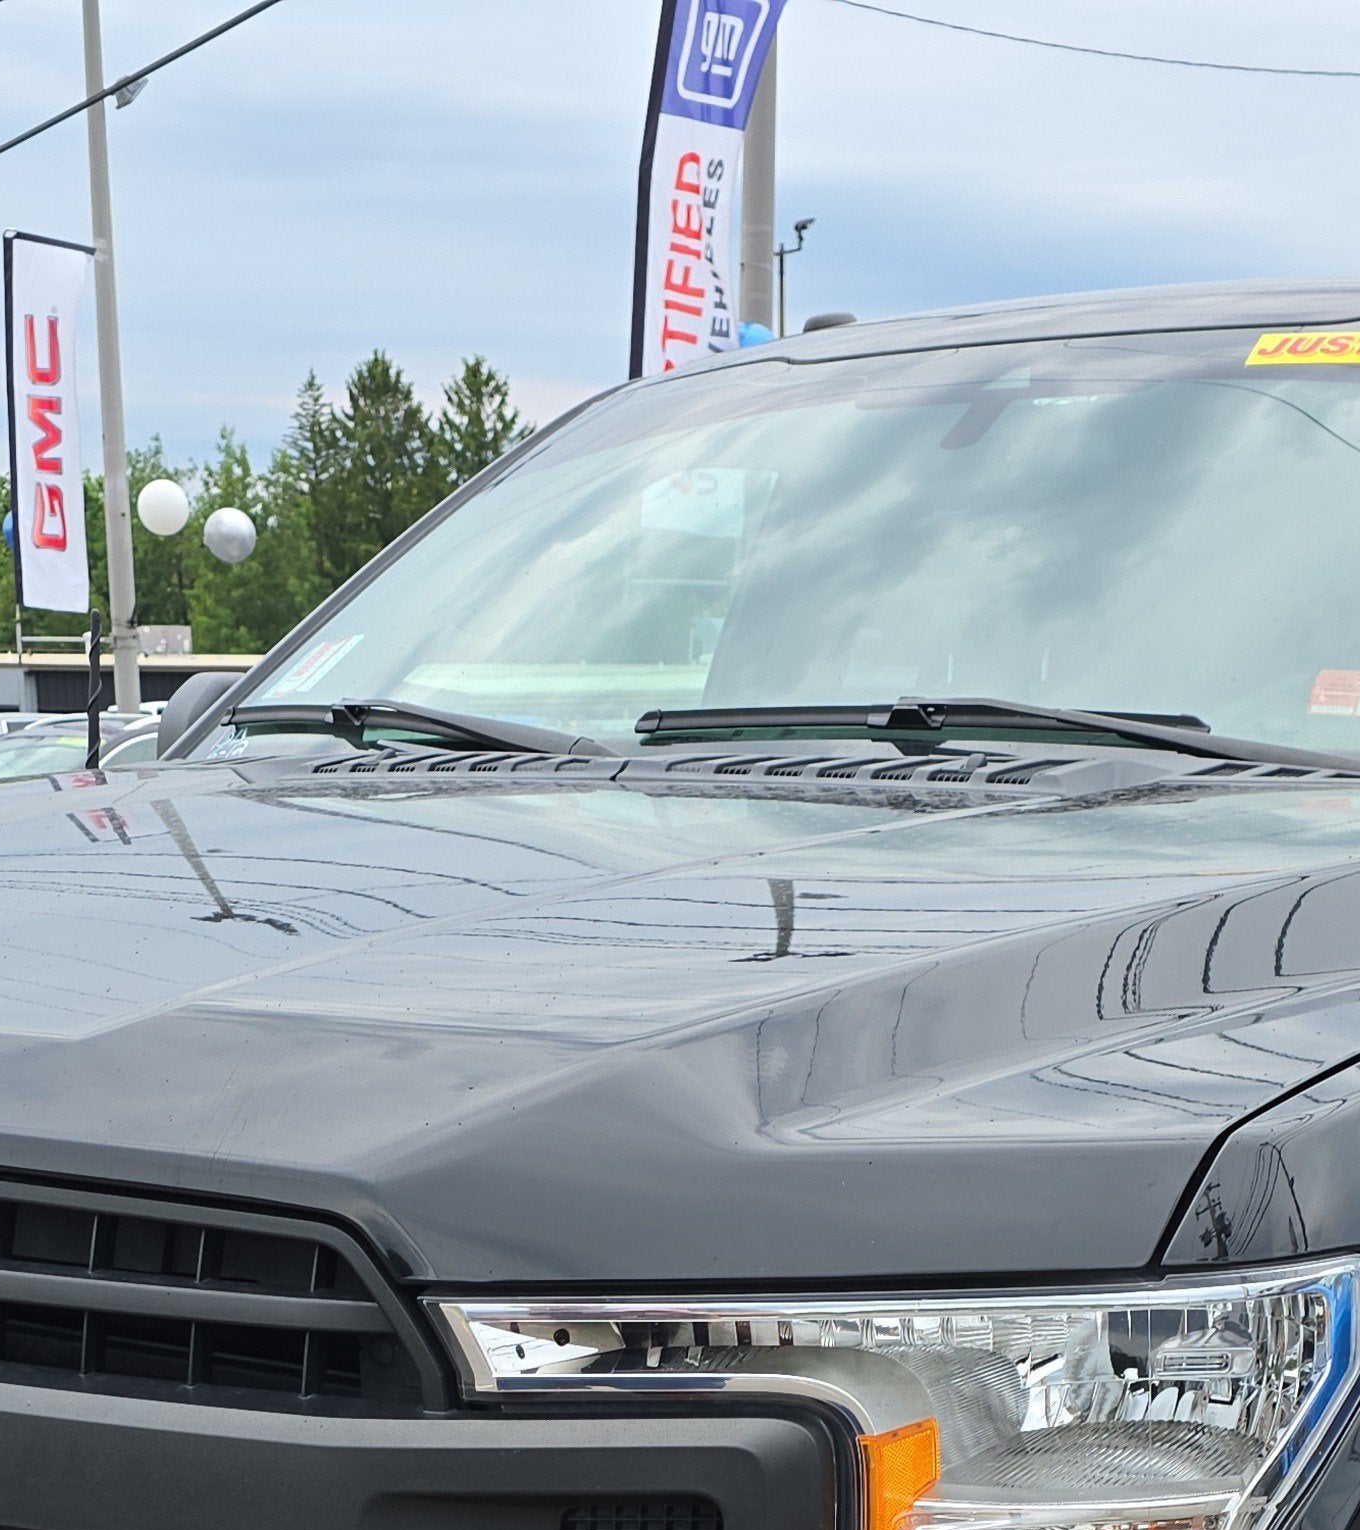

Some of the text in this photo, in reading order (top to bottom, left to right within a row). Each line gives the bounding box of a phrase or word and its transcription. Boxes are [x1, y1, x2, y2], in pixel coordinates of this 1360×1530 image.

[701, 11, 744, 74] gm
[661, 151, 706, 373] TIFIED
[24, 313, 68, 552] GMC
